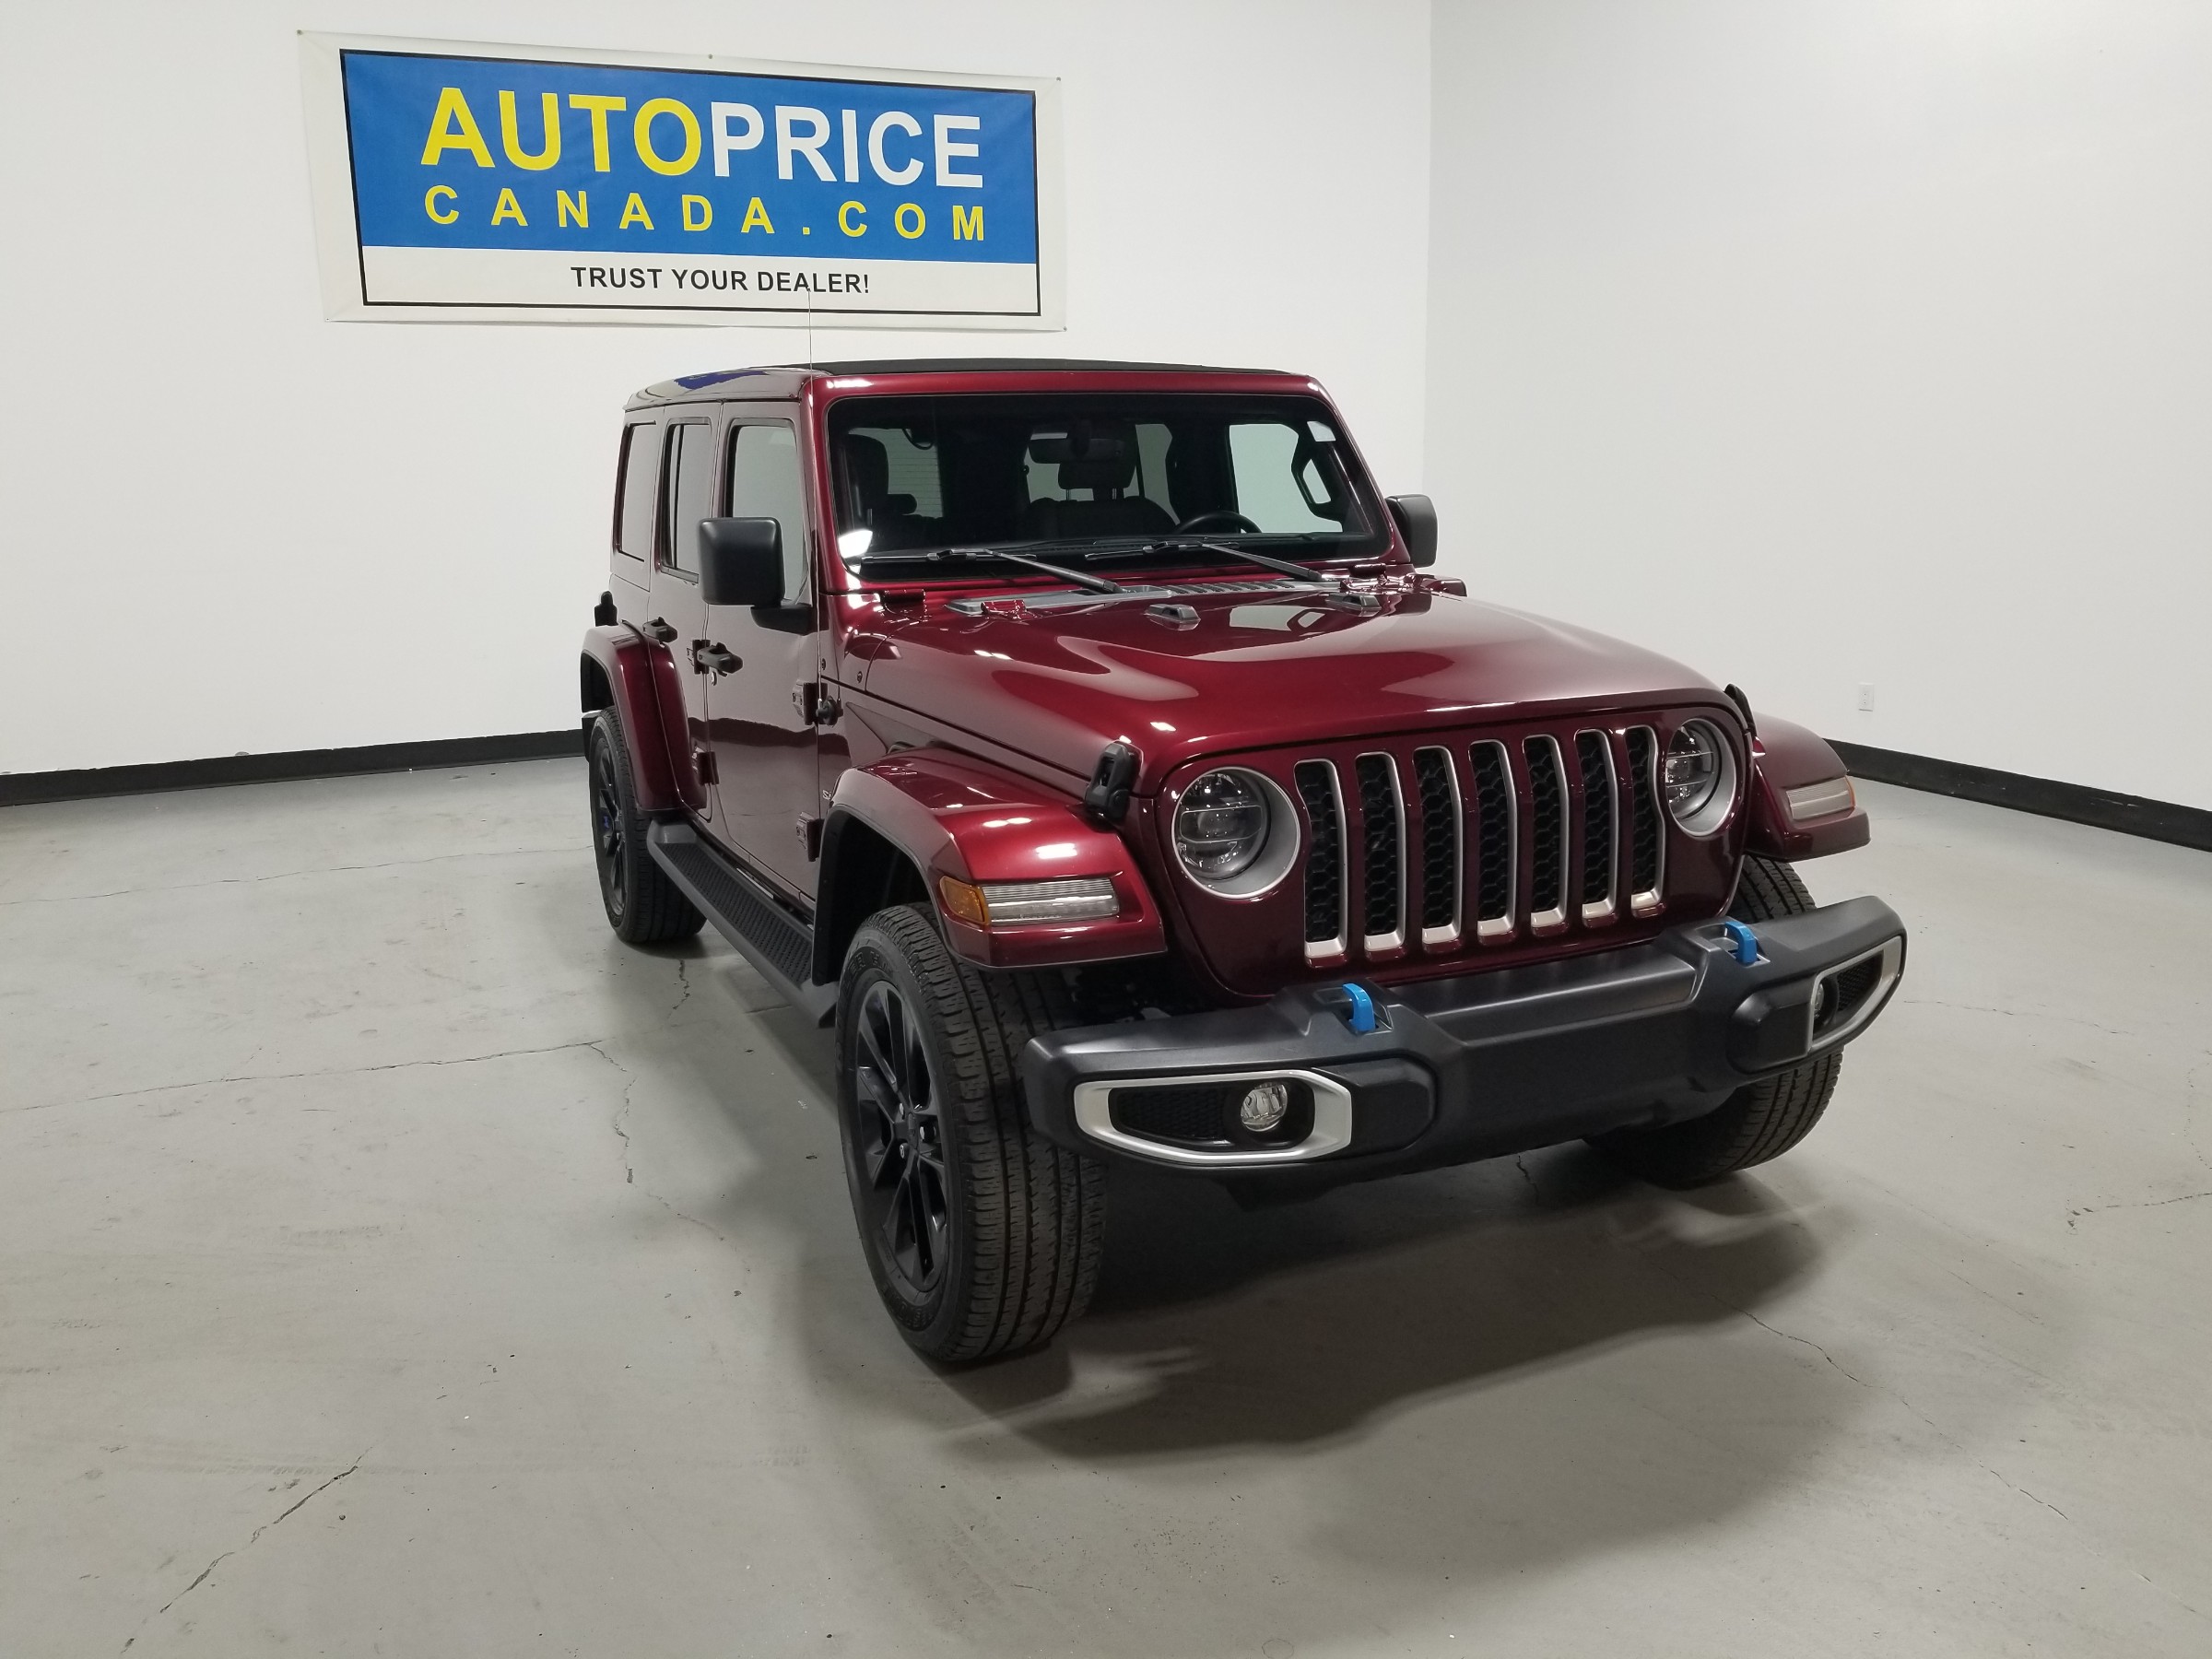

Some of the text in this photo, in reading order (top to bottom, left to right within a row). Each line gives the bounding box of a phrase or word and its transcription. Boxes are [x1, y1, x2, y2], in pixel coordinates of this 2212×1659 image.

[420, 87, 984, 189] AUTOPRICE
[424, 184, 984, 241] CANADA.COM
[570, 265, 870, 294] TRUST YOUR DEALER!
